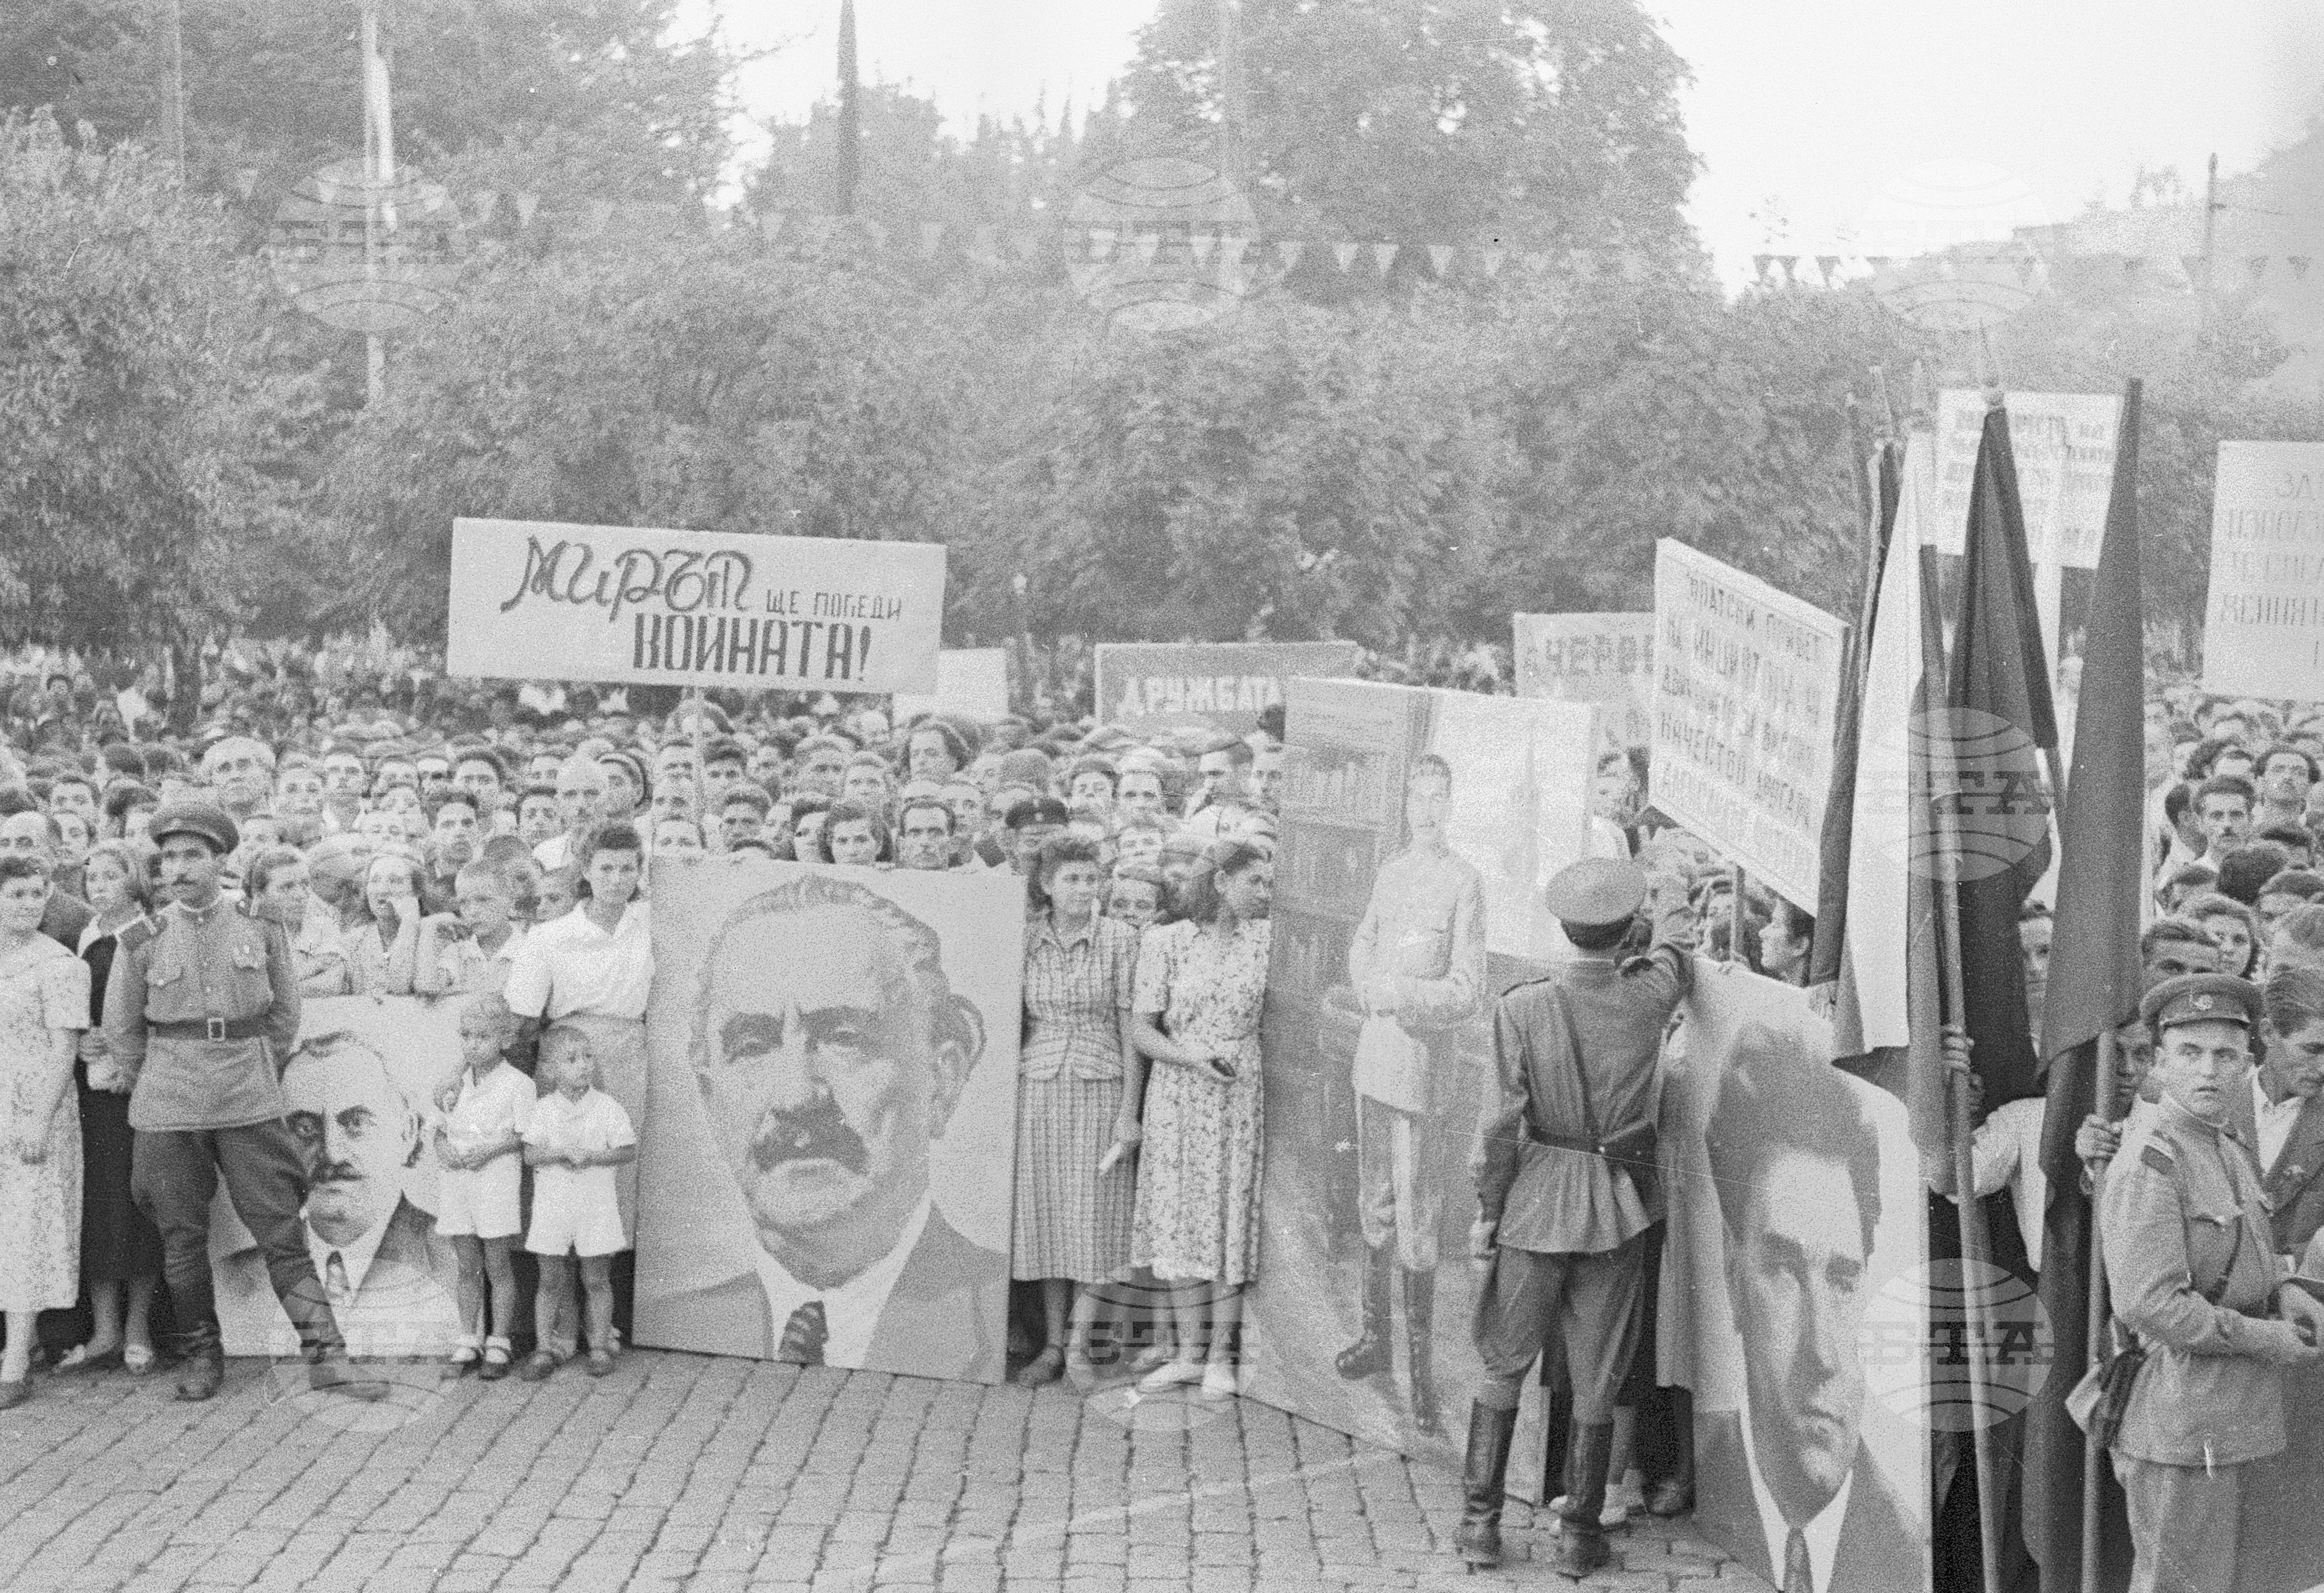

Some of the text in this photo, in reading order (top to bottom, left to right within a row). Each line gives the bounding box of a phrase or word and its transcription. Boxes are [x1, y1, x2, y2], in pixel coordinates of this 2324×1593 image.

[766, 588, 799, 615] ЩЕ
[814, 590, 902, 621] ПОБЕДИ
[633, 611, 872, 682] ВОЙНАТА!
[1116, 675, 1282, 718] ДРУЖБАТА
